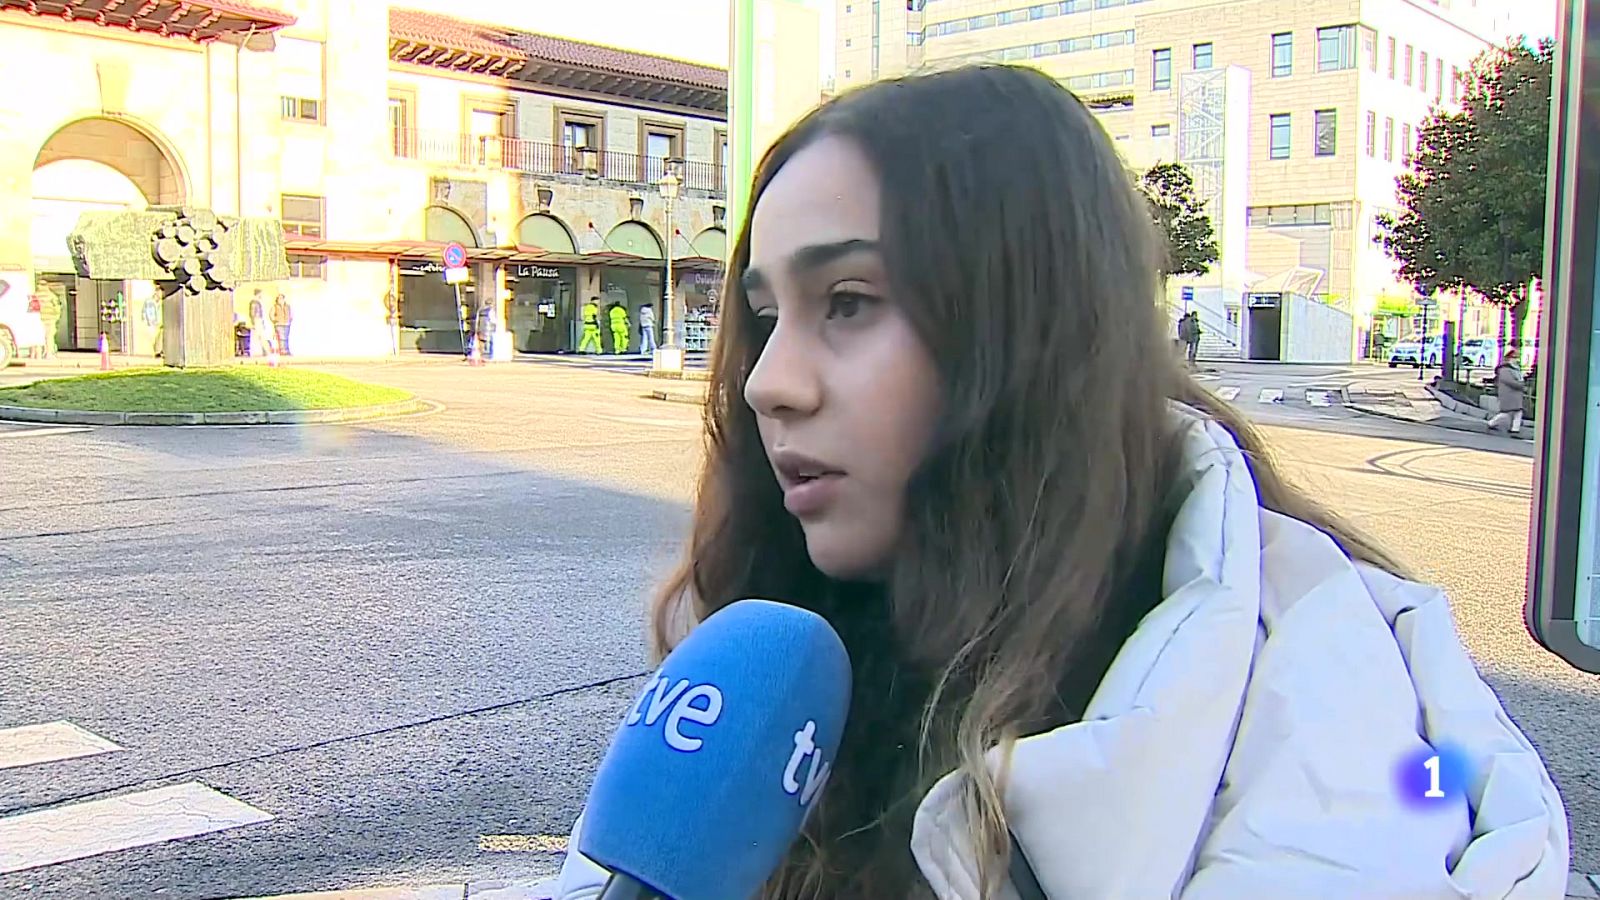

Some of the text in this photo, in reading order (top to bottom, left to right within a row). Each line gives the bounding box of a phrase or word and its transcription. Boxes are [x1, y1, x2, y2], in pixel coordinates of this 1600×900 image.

[518, 264, 560, 278] La Pausa
[627, 668, 723, 751] tve
[783, 720, 831, 808] tv
